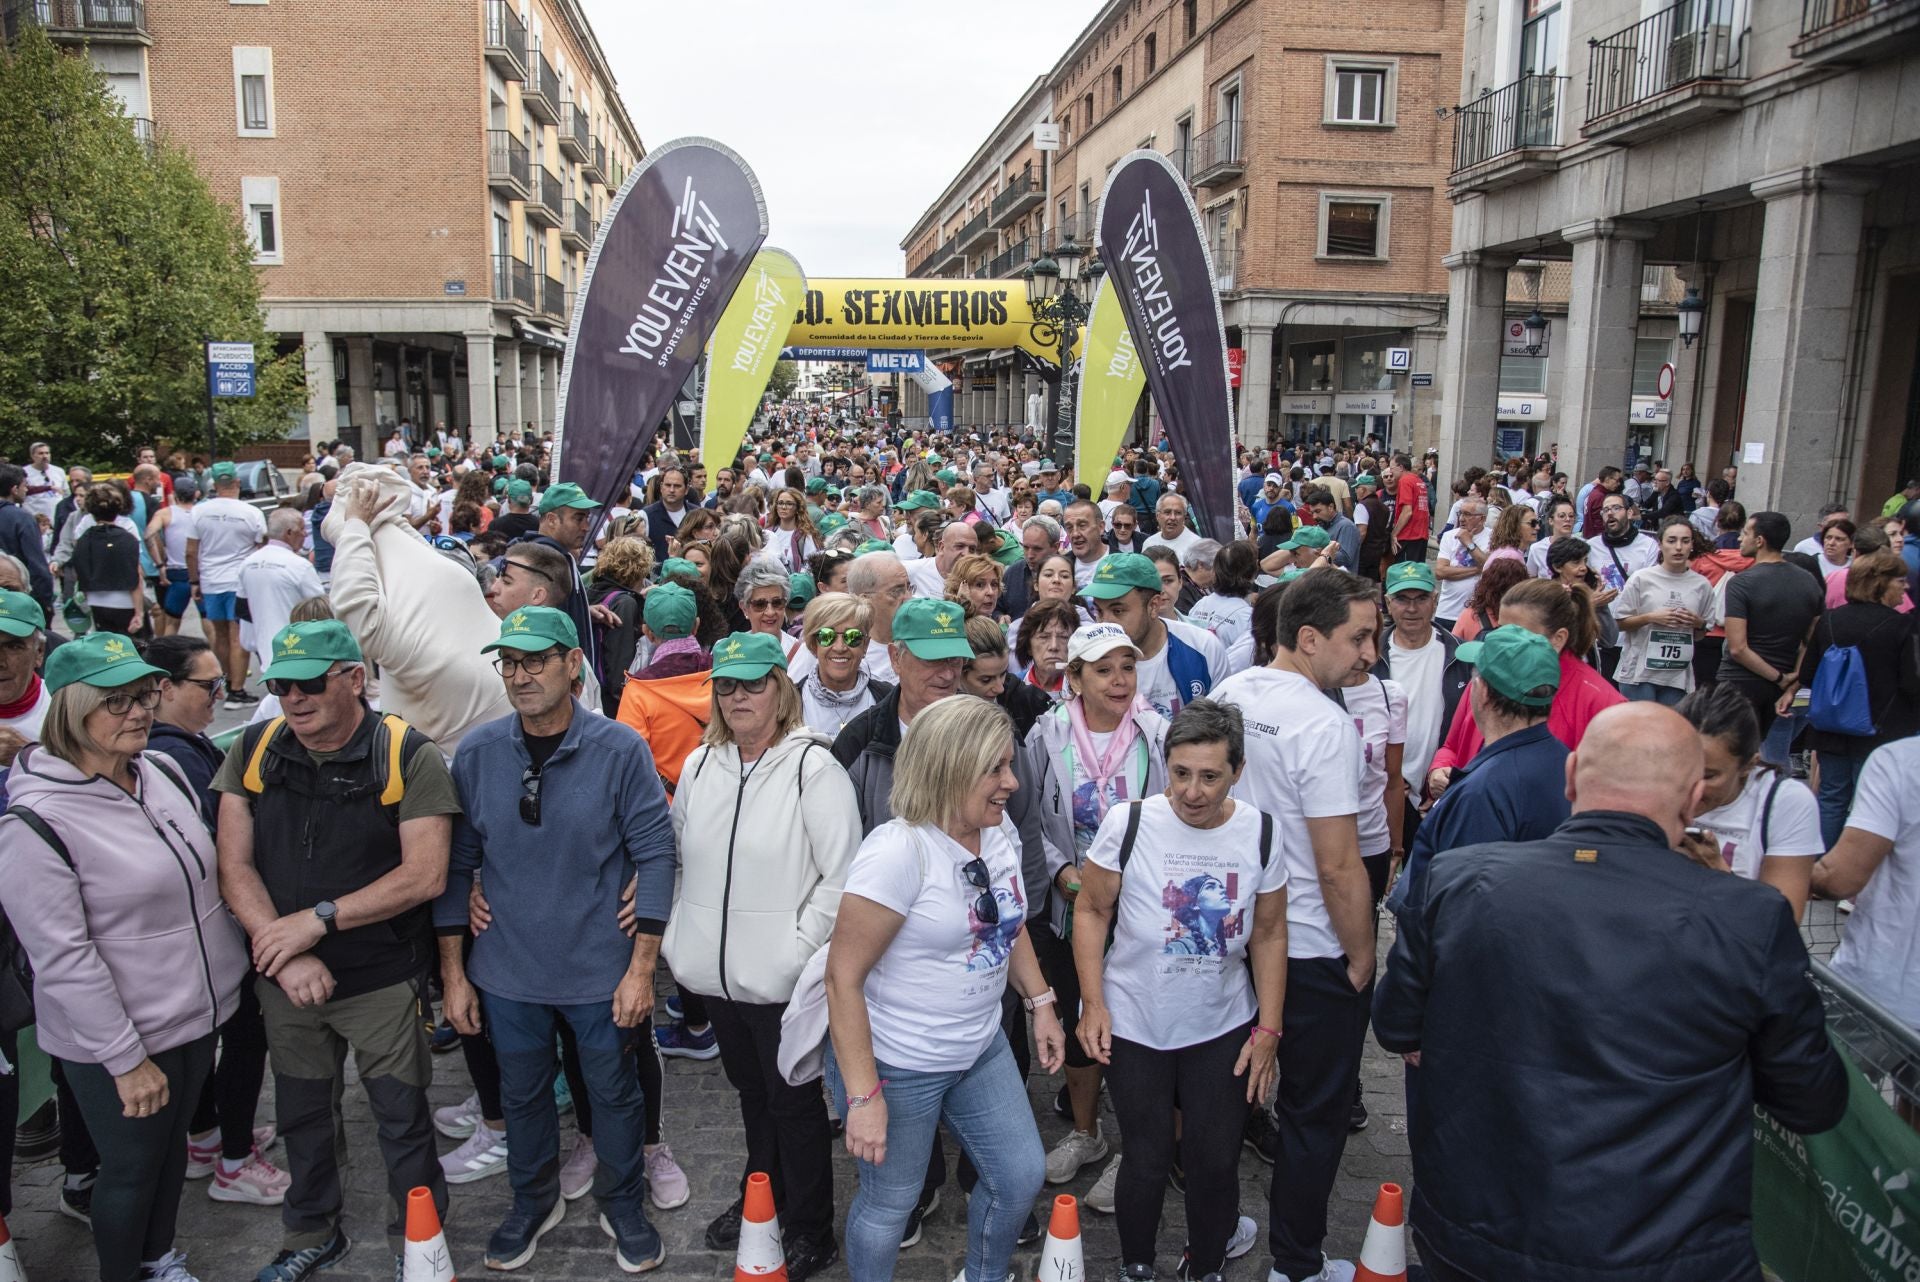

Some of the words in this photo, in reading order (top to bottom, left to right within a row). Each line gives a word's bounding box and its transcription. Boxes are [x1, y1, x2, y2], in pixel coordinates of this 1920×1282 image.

[843, 289, 1007, 331] SEXMEROS
[658, 327, 684, 367] SPORTS
[680, 276, 710, 326] SERVICES
[799, 348, 836, 356] DEPORTES
[841, 349, 868, 357] SEGOVI
[872, 354, 920, 368] META
[216, 371, 251, 379] PEATONAL
[1086, 626, 1104, 640] NEW
[1660, 645, 1682, 659] 175
[1213, 861, 1226, 869] Caja
